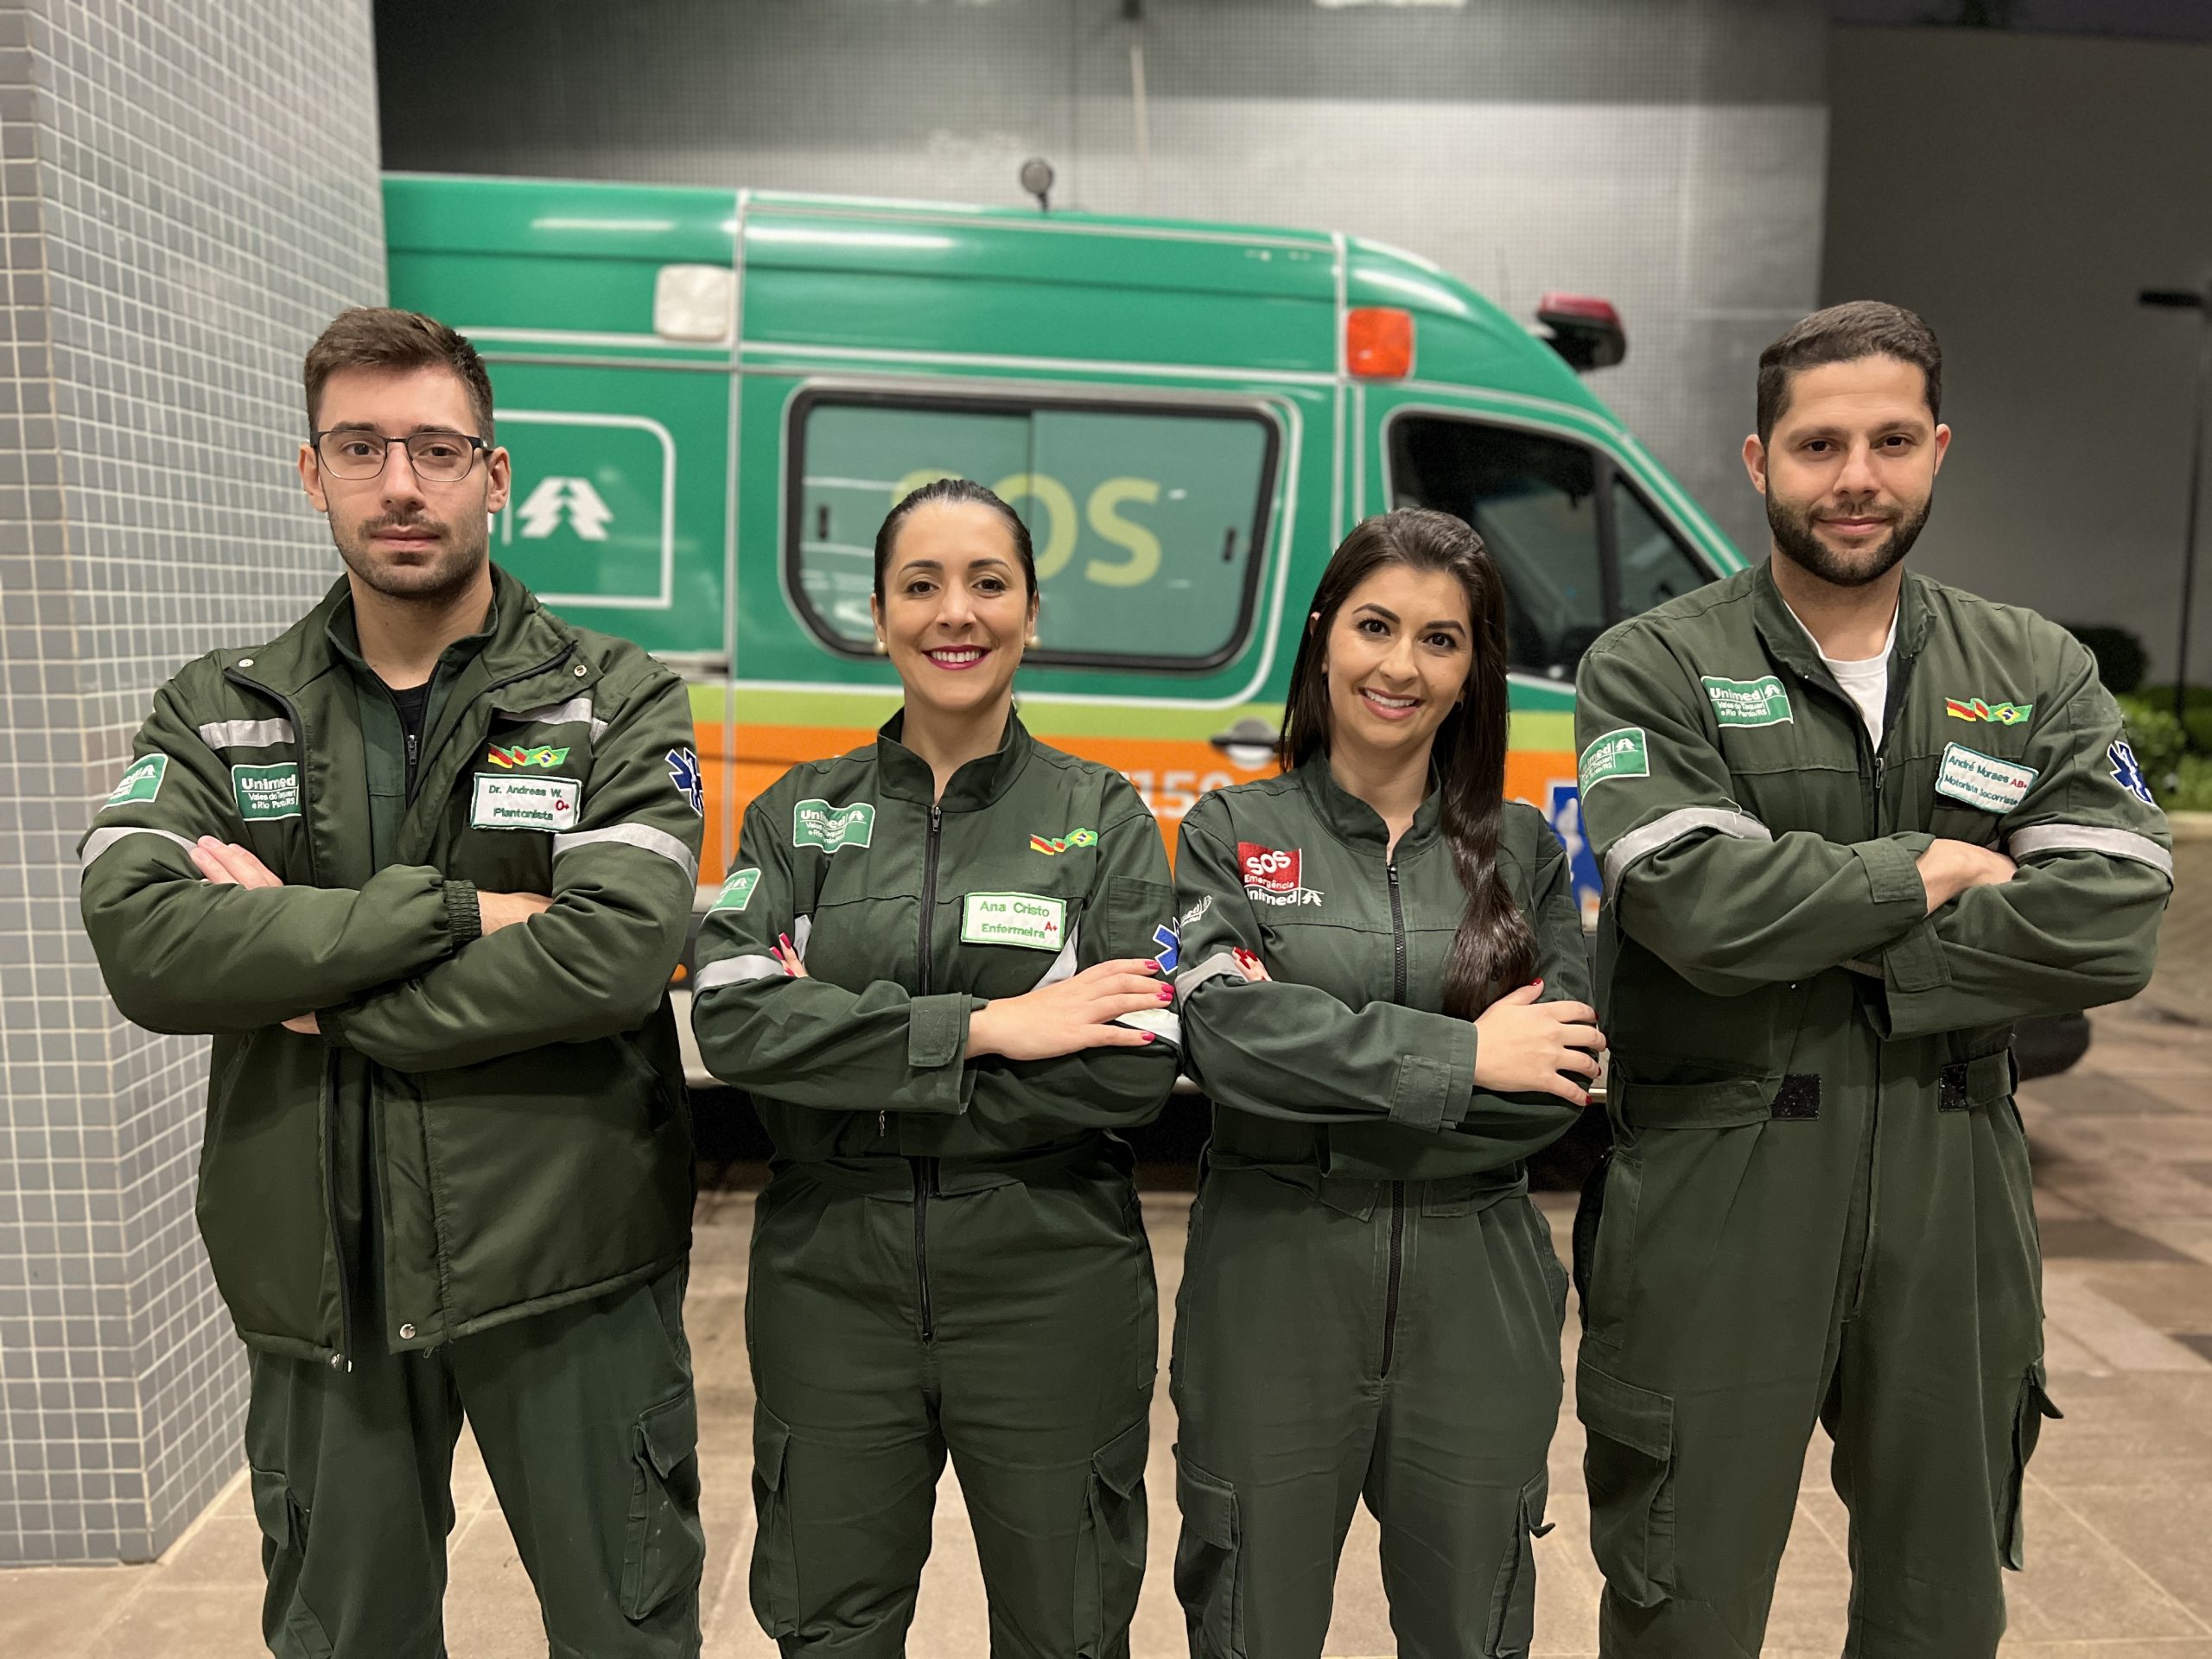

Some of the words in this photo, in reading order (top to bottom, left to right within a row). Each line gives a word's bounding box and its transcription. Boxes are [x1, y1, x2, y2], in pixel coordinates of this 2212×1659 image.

[892, 468, 1162, 588] OS
[1710, 688, 1761, 701] Unimed
[1948, 755, 1975, 772] André
[1977, 766, 2009, 783] Moraes
[2010, 779, 2027, 789] AB+
[242, 774, 296, 790] Unimed
[1945, 775, 1978, 793] Motorista
[1980, 788, 2018, 805] Socorrista
[248, 792, 268, 801] Vales
[269, 791, 277, 800] do
[489, 785, 502, 793] Dr.
[506, 785, 546, 796] Andreas
[550, 788, 562, 798] W.
[1120, 771, 1234, 818] 15
[493, 808, 553, 821] Plantonista
[1247, 851, 1291, 875] SOS
[1244, 874, 1294, 889] Emergência
[1247, 889, 1297, 906] nimed
[980, 901, 1006, 912] Ana
[1014, 902, 1049, 917] Cristo
[982, 924, 1045, 938] Enfermeira
[1045, 921, 1058, 931] A+
